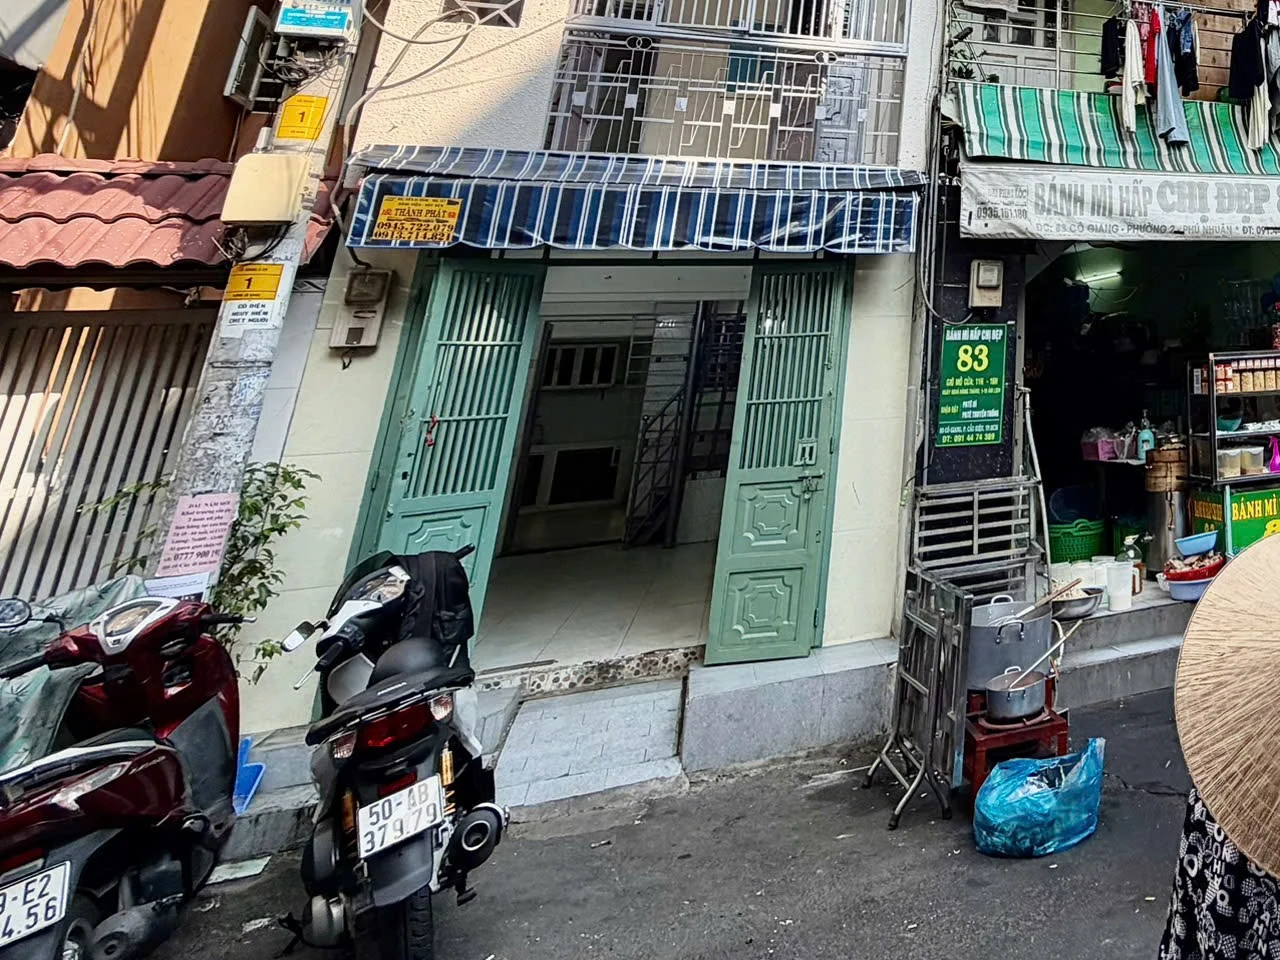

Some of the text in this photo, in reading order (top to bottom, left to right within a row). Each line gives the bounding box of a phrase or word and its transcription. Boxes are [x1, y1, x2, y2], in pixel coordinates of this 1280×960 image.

[298, 111, 305, 122] 1
[1034, 176, 1085, 216] BÁNH
[1090, 177, 1112, 217] MÌ
[1119, 179, 1153, 217] HẤP
[1157, 180, 1210, 223] CHỊ
[1214, 182, 1270, 223] ĐẸP
[245, 277, 253, 289] 1
[957, 344, 989, 372] 83
[1232, 497, 1263, 520] BÁNH
[1264, 494, 1278, 516] MÌ
[369, 783, 429, 826] 50-AB
[364, 803, 437, 853] 379.79
